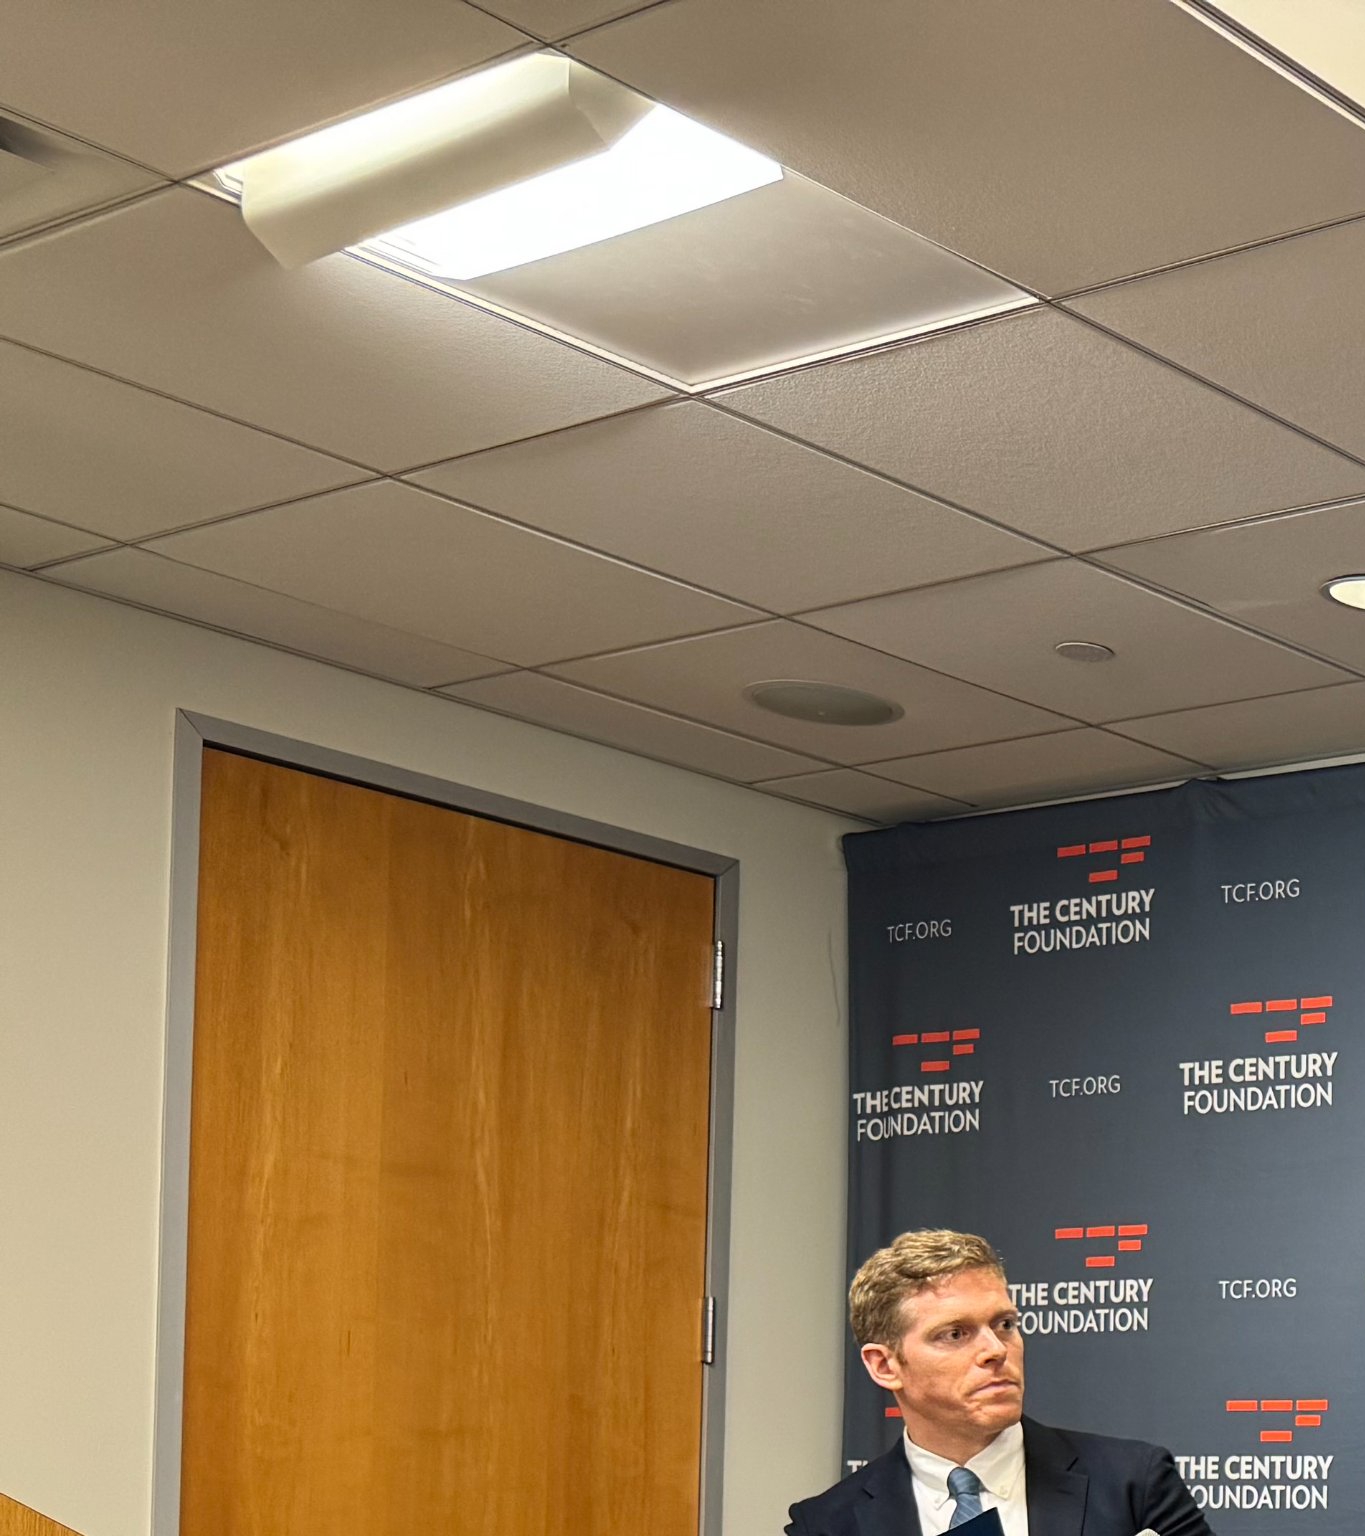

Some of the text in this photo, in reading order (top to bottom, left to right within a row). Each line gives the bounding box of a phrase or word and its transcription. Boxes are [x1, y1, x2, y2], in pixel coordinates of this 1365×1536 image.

[1221, 879, 1299, 903] TCF.ORG
[1010, 889, 1154, 926] THE CENTURY
[888, 920, 951, 942] TCF.ORG
[1015, 918, 1149, 954] FOUNDATION
[1180, 1052, 1337, 1085] THE CENTURY
[853, 1081, 983, 1114] THE CENTURY
[1050, 1075, 1120, 1097] TCF.ORG
[1184, 1082, 1332, 1114] FOUNDATION
[858, 1109, 979, 1141] FOUNDATION
[1008, 1279, 1153, 1307] THE CENTURY
[1219, 1278, 1296, 1298] TCF.ORG
[1017, 1308, 1148, 1334] OUNDATION
[1175, 1456, 1333, 1479] THE CENTURY
[1187, 1485, 1328, 1509] OUNDATION
